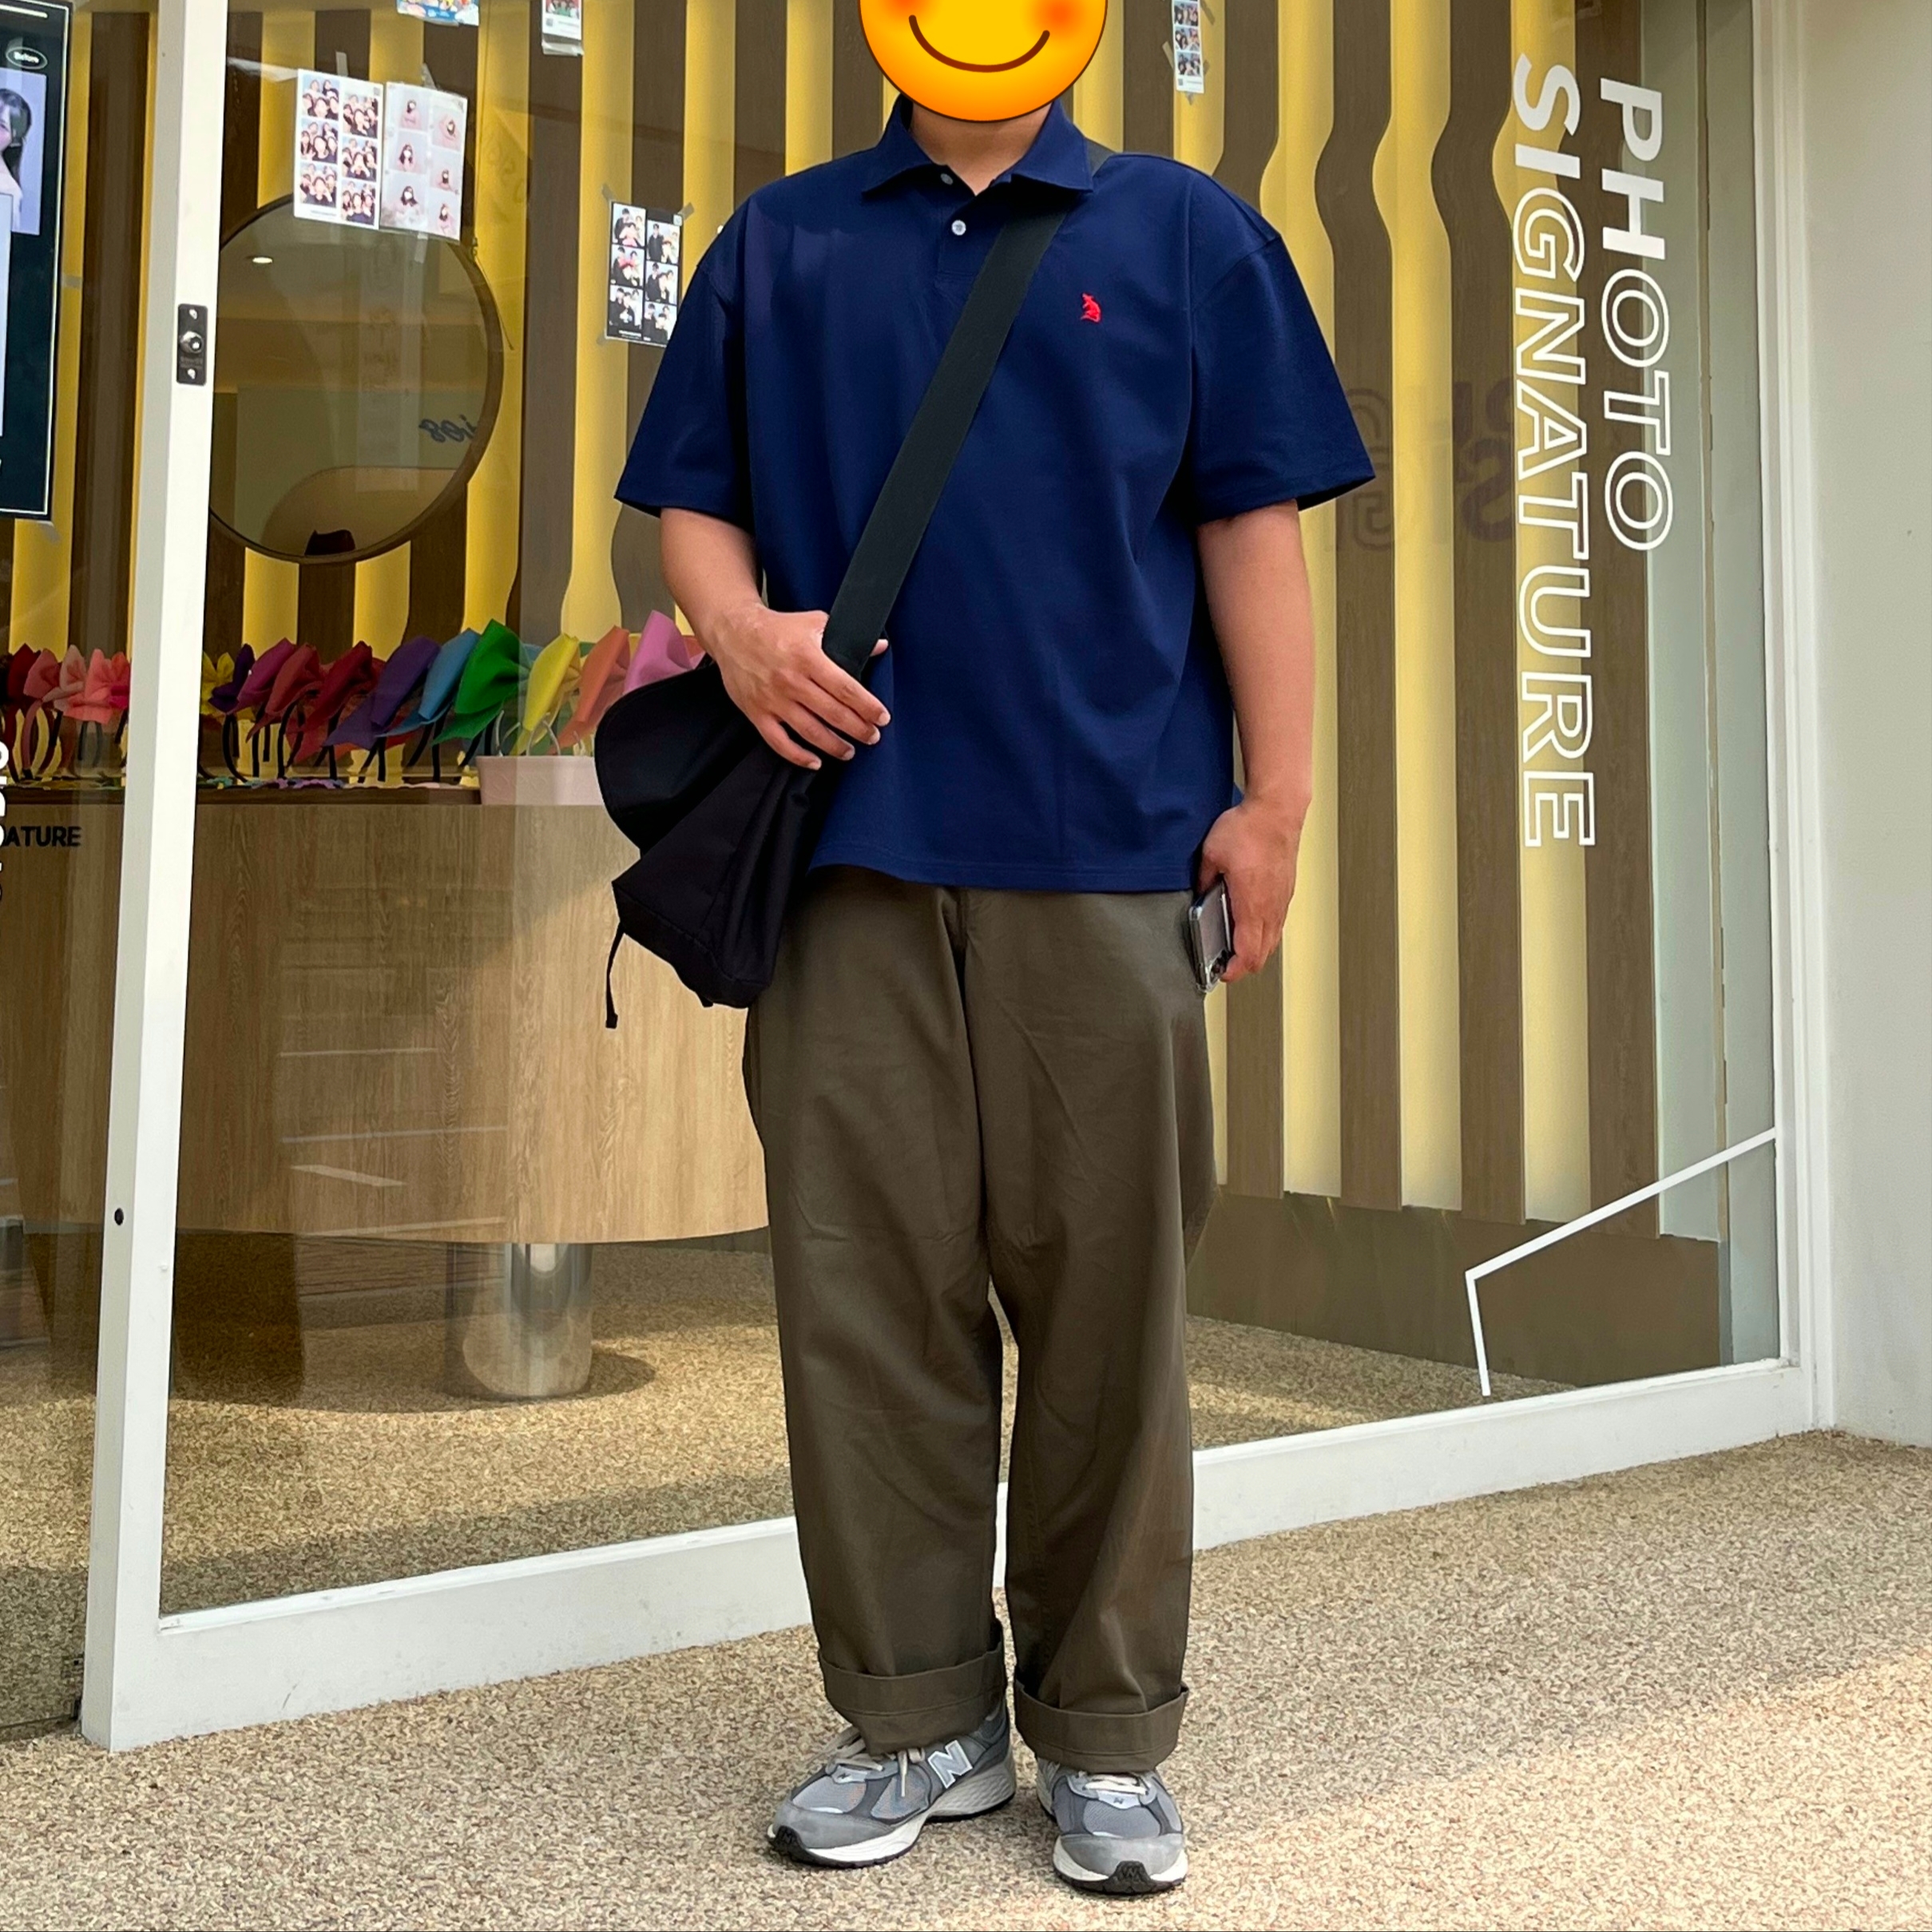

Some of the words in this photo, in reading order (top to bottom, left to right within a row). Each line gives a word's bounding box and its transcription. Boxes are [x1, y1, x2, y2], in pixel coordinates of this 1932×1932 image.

[1601, 77, 1674, 550] PHOTO
[1513, 53, 1596, 847] SIGNATURE
[1, 826, 82, 847] ATURE
[927, 1740, 973, 1789] N
